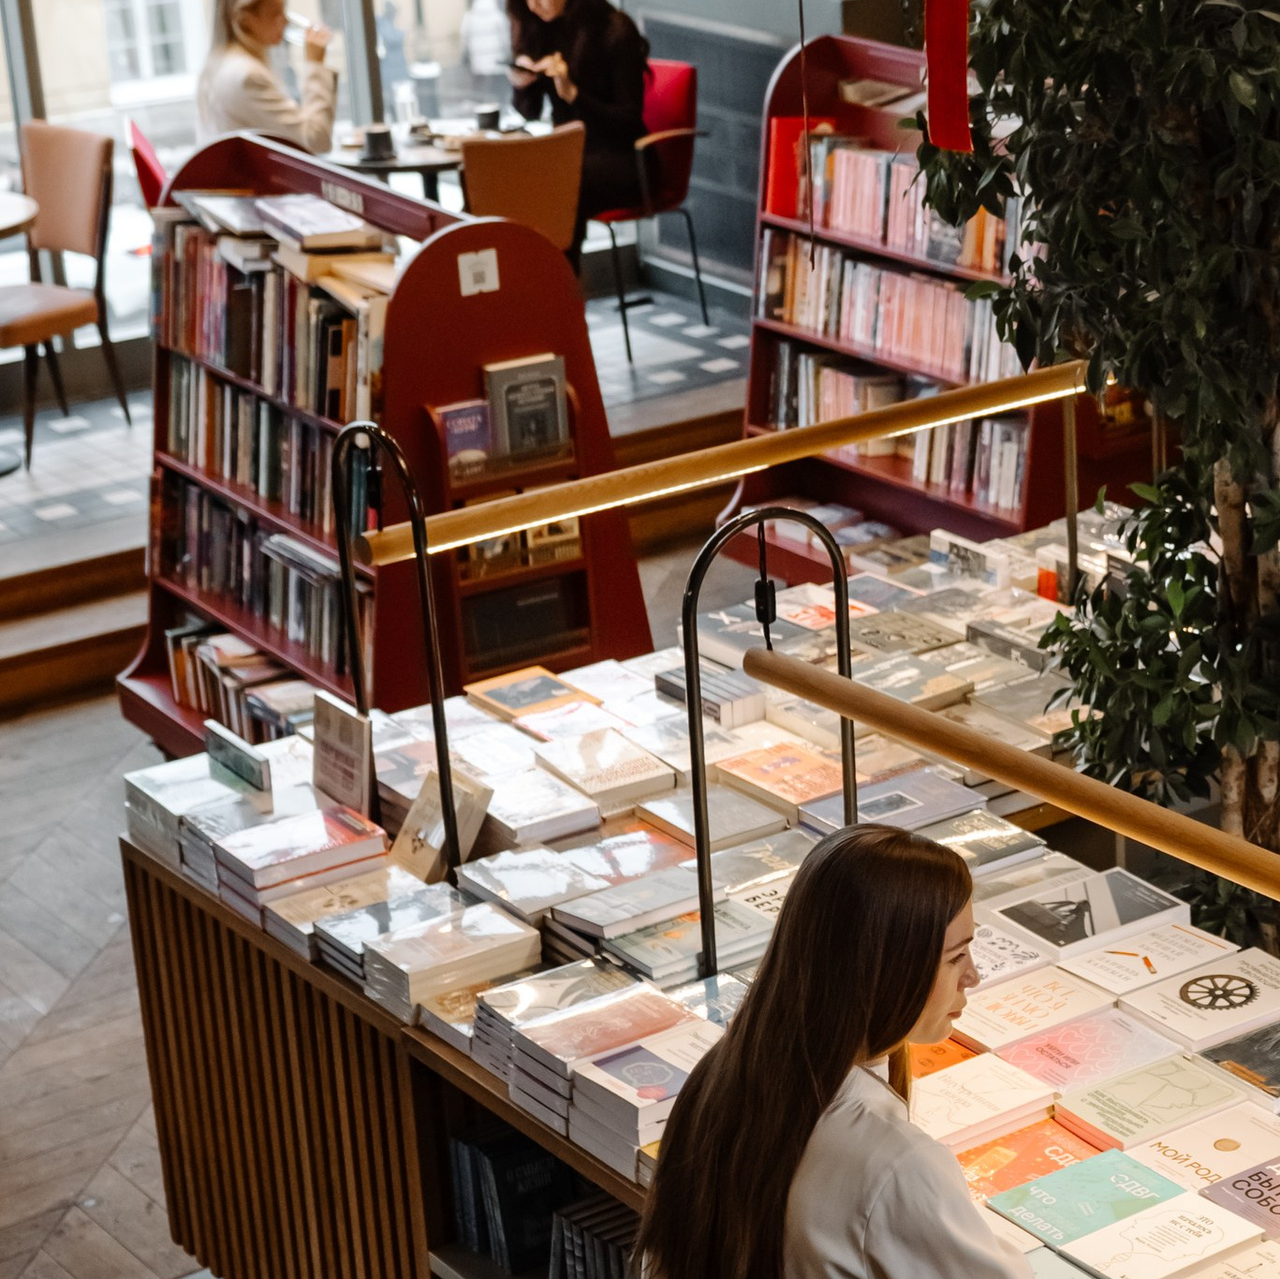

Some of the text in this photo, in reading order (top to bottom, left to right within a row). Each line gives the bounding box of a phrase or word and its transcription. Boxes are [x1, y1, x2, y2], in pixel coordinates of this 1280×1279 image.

[1149, 1141, 1223, 1184] МОЙ РОД
[1109, 1173, 1160, 1199] СДВГ
